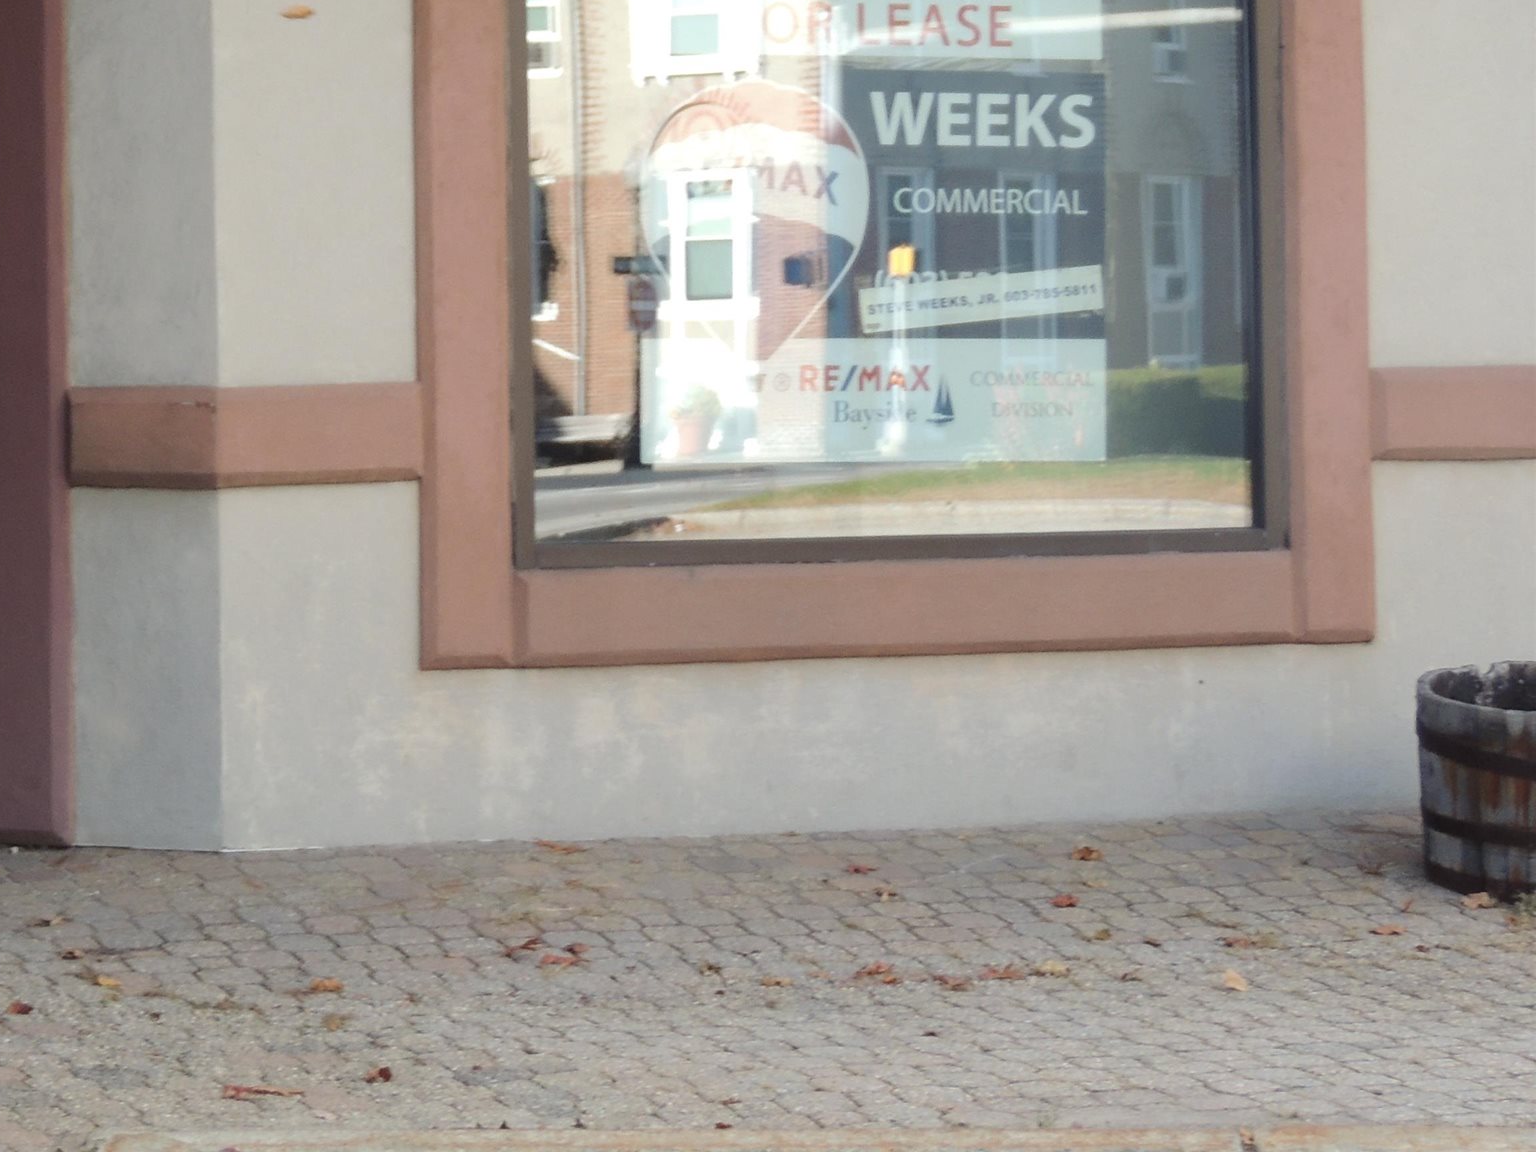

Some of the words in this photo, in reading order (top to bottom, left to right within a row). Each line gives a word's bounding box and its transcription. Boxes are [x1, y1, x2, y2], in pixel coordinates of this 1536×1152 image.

[856, 2, 1014, 47] LEASE
[869, 90, 1096, 148] WEEKS
[893, 187, 1088, 215] COMMERCIAL
[917, 295, 974, 310] WEEKS,
[799, 364, 931, 392] RE/MAX
[969, 369, 1095, 387] COMMERCIAL
[833, 400, 917, 430] Baysie
[991, 402, 1074, 418] DIVISION
